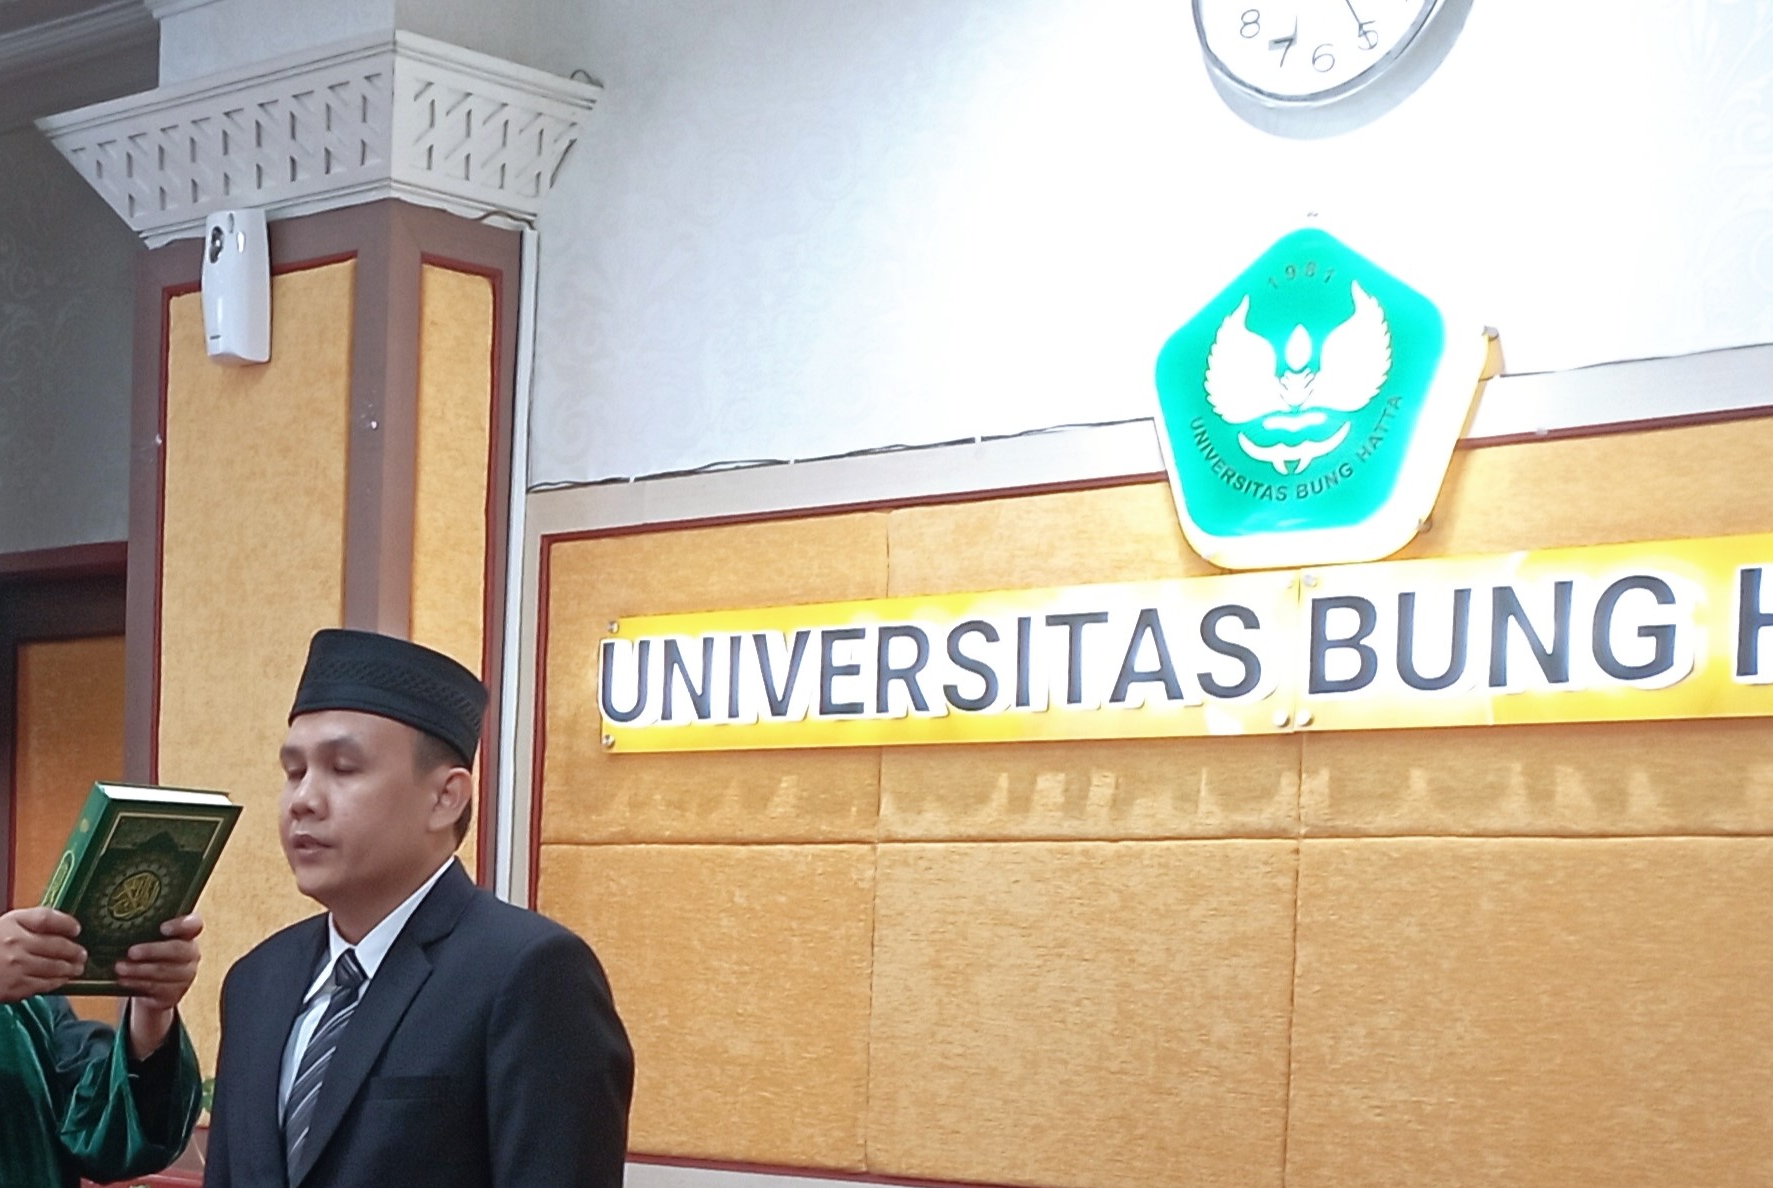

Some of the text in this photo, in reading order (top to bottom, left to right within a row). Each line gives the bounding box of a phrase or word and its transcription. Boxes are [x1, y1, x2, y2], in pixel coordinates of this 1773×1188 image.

[1240, 9, 1260, 38] 8
[1358, 20, 1378, 50] 5
[1274, 38, 1294, 68] 7
[1312, 43, 1335, 72] 6
[1268, 261, 1336, 289] 1981
[1190, 395, 1403, 502] UNIVERSITAS BUNG HATTA
[598, 604, 1263, 722] UNIVERSITAS
[1308, 575, 1678, 696] BUNG
